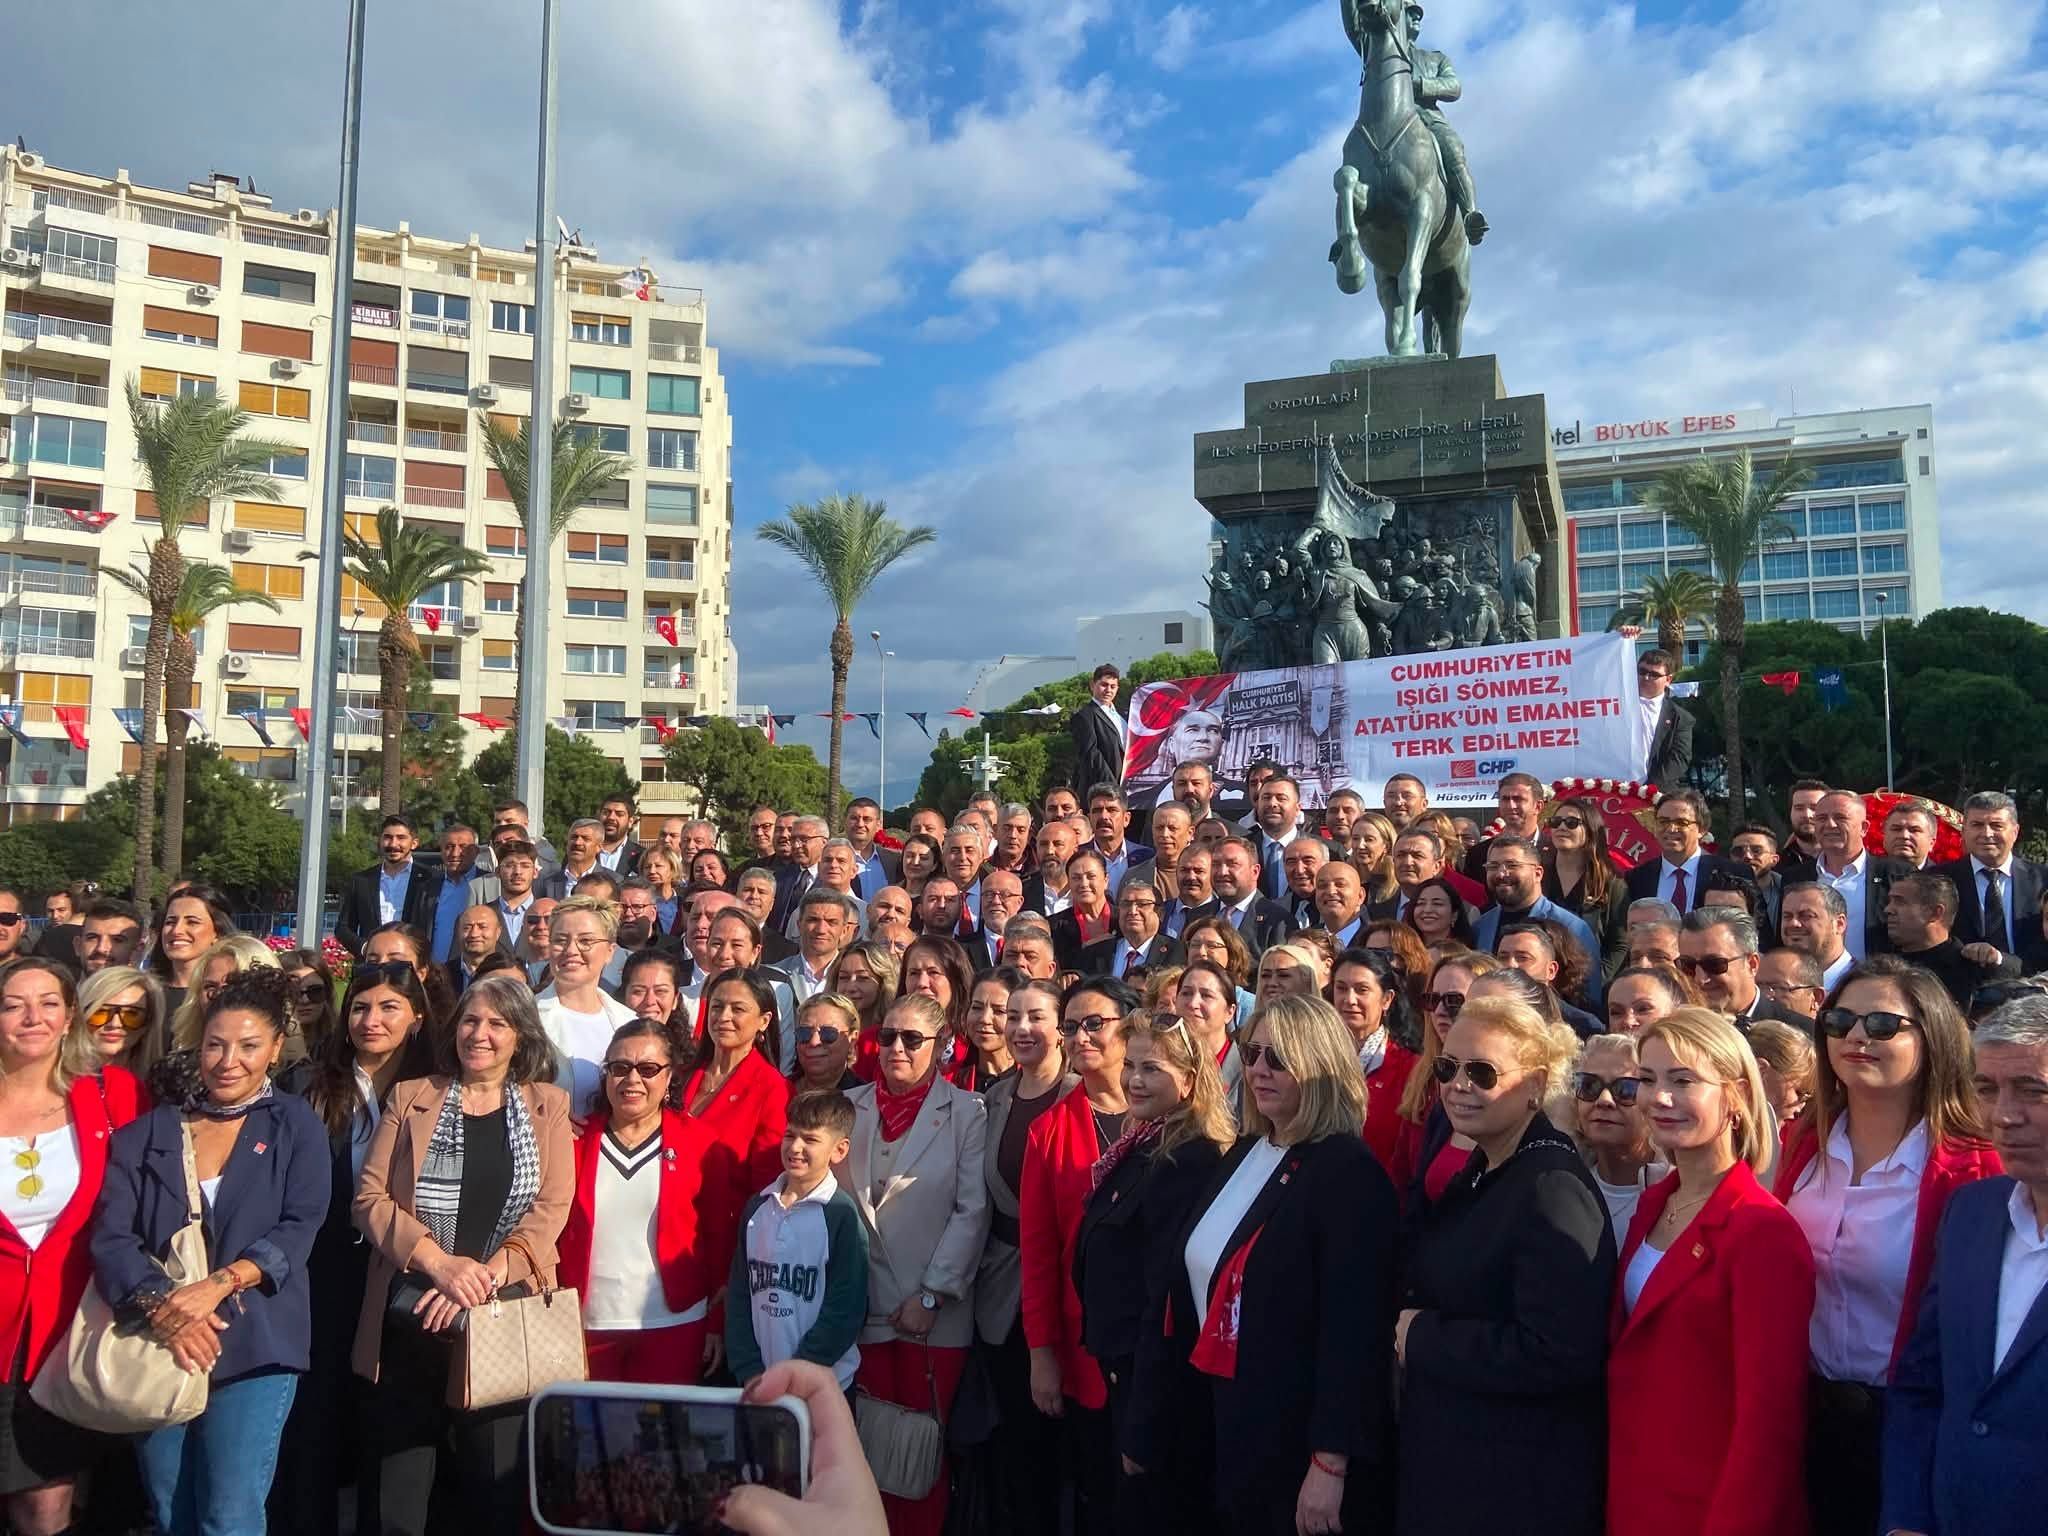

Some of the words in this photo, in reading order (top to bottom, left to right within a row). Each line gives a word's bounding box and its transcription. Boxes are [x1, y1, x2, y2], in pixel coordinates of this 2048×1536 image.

[1268, 387, 1358, 409] ORDULAR!
[1551, 420, 1580, 446] tel
[1594, 420, 1670, 441] BÜYÜK
[1391, 649, 1572, 682] CUMHURİYETİN
[1232, 699, 1258, 713] HALK
[1397, 682, 1448, 711] IŞIĞI
[1457, 675, 1568, 701] SÖNMEZ,
[1354, 704, 1498, 736] ATATÜRK'ÜN
[1507, 698, 1620, 723] EMANETİ
[1392, 737, 1455, 757] TERK
[1463, 728, 1579, 753] EDİLMEZ!
[1478, 759, 1515, 775] CHP
[1436, 791, 1488, 802] Hüseyin
[748, 1259, 818, 1303] CHICAGO
